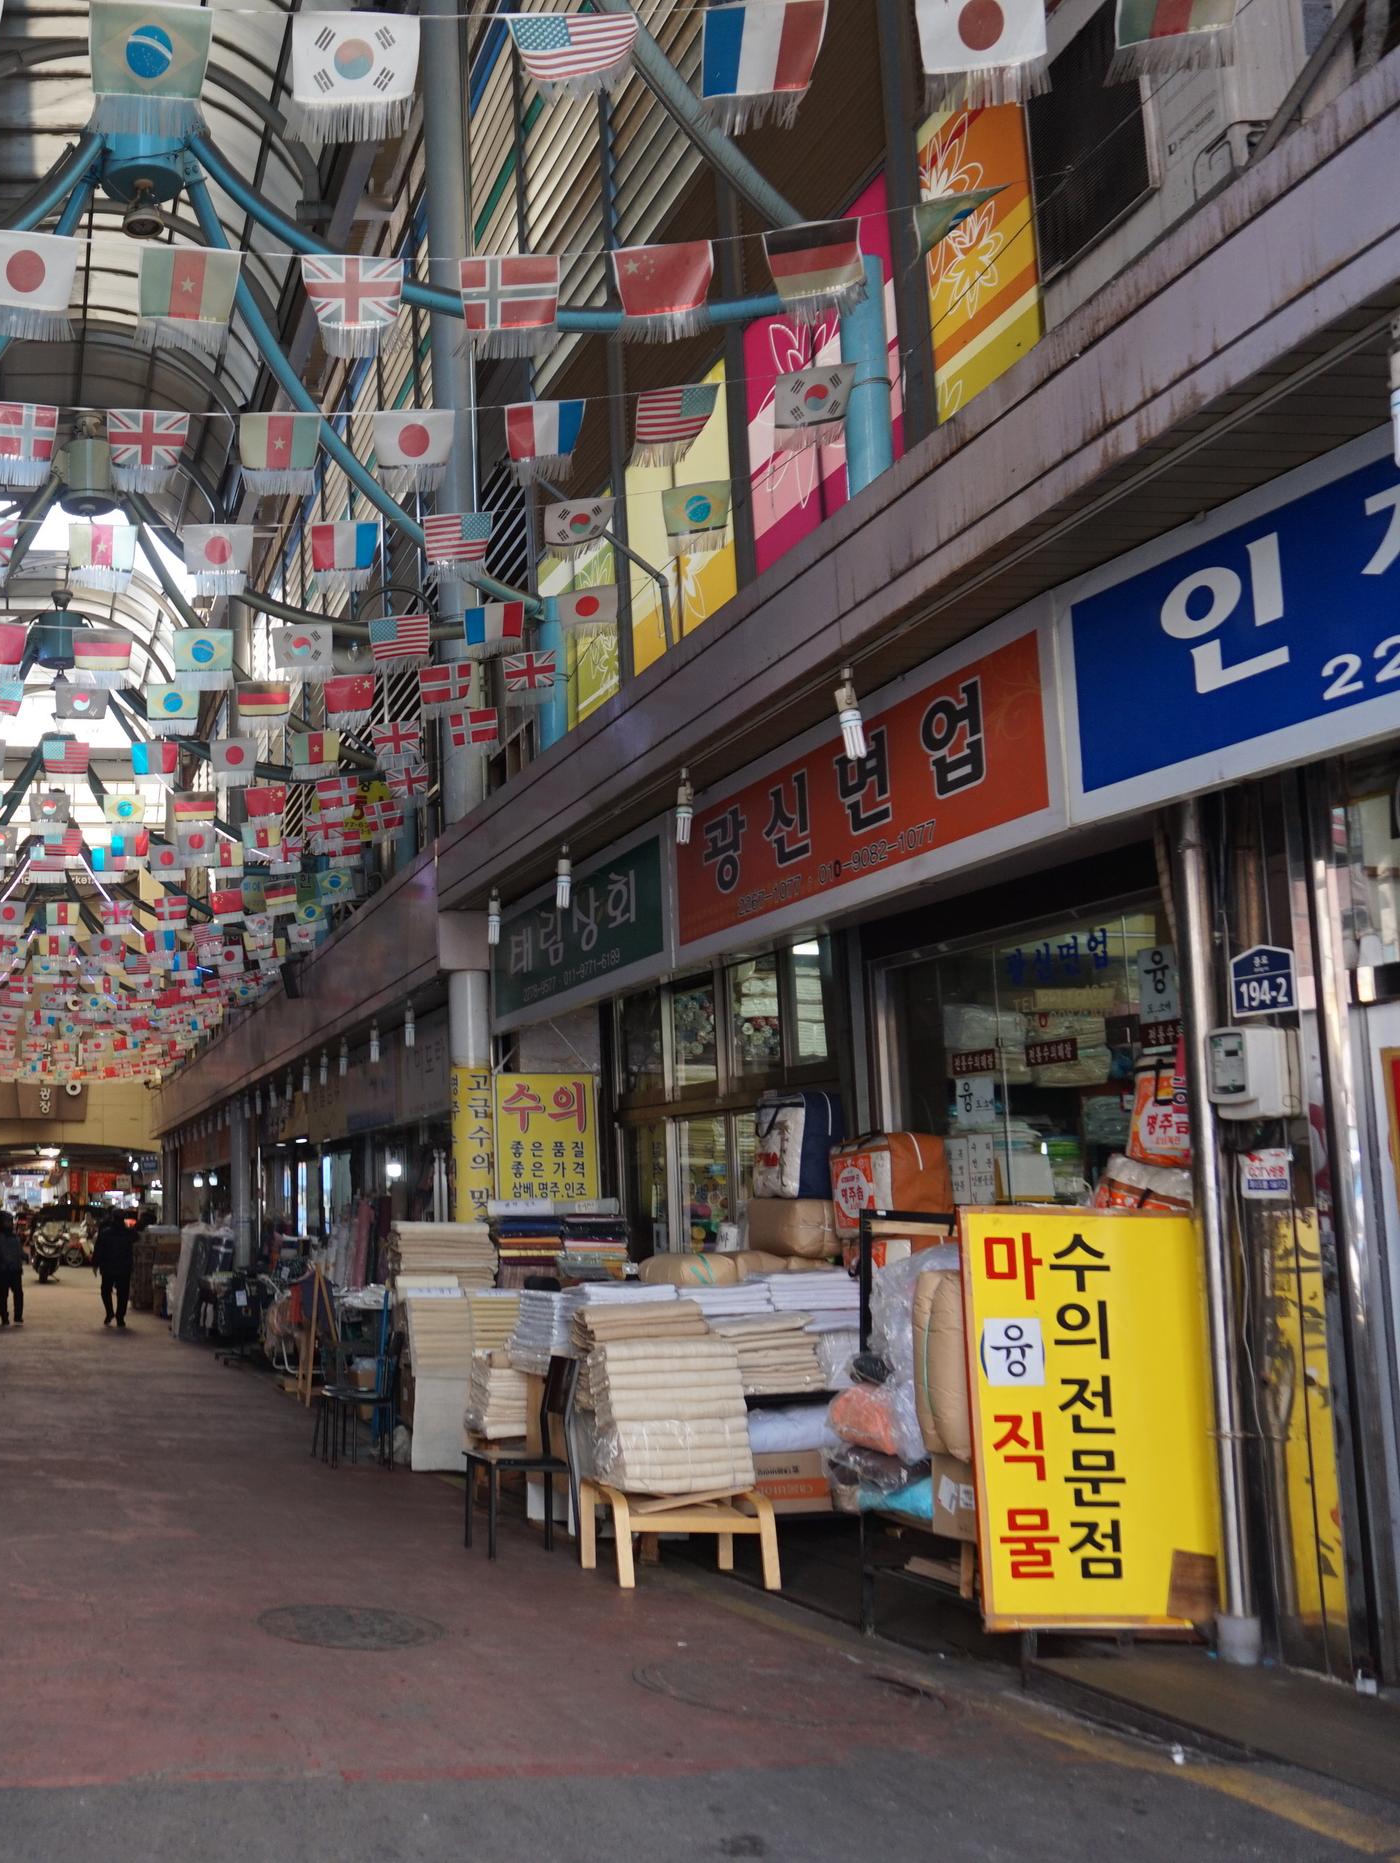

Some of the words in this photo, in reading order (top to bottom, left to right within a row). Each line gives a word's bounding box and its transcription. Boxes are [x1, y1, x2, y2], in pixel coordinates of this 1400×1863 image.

[817, 820, 936, 884] 010-9082-1077
[1240, 976, 1289, 1009] 194-2
[502, 1081, 588, 1133] 수의
